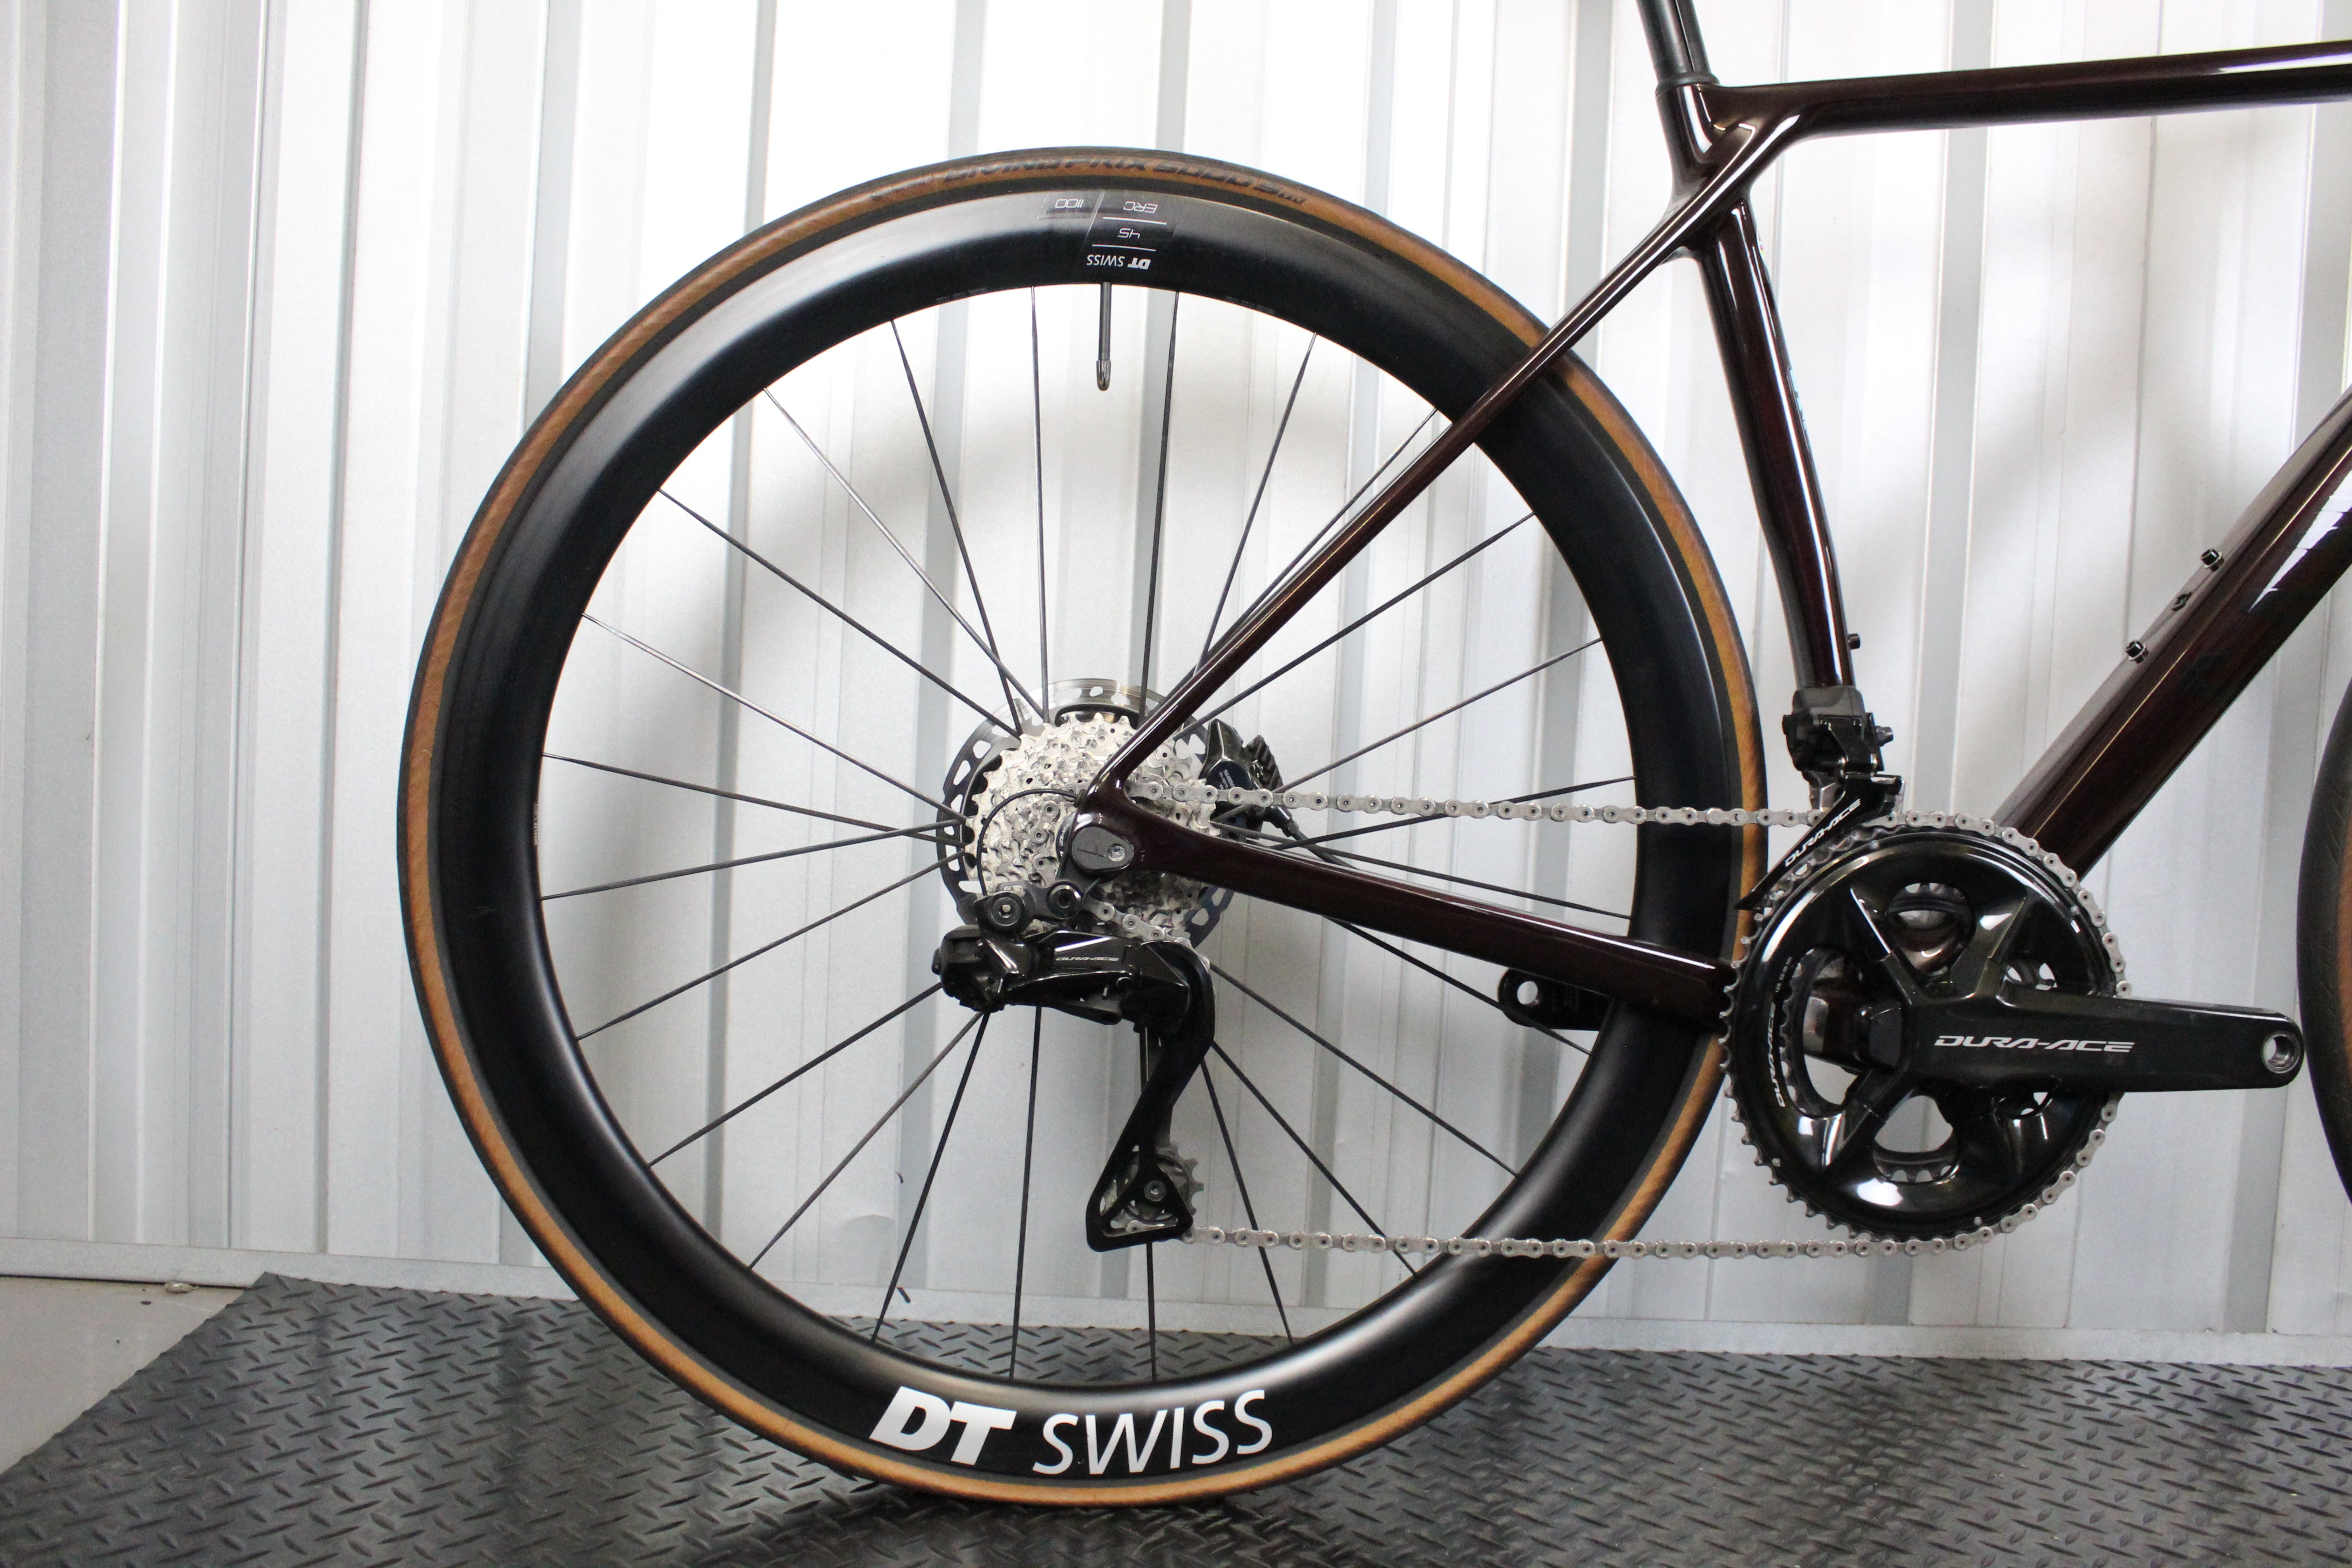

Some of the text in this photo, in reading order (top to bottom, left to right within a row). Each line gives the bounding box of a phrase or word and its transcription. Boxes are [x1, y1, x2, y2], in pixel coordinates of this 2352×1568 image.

[1055, 199, 1084, 209] 1100
[1123, 201, 1158, 214] ERC
[1117, 227, 1141, 239] 45
[1086, 254, 1152, 270] DT SWISS
[1785, 799, 1861, 867] DURA-ACE
[1934, 1035, 2135, 1053] DURA-ACE
[1768, 1001, 1786, 1107] DURA-ACE
[869, 1386, 1273, 1475] DT SWISS
